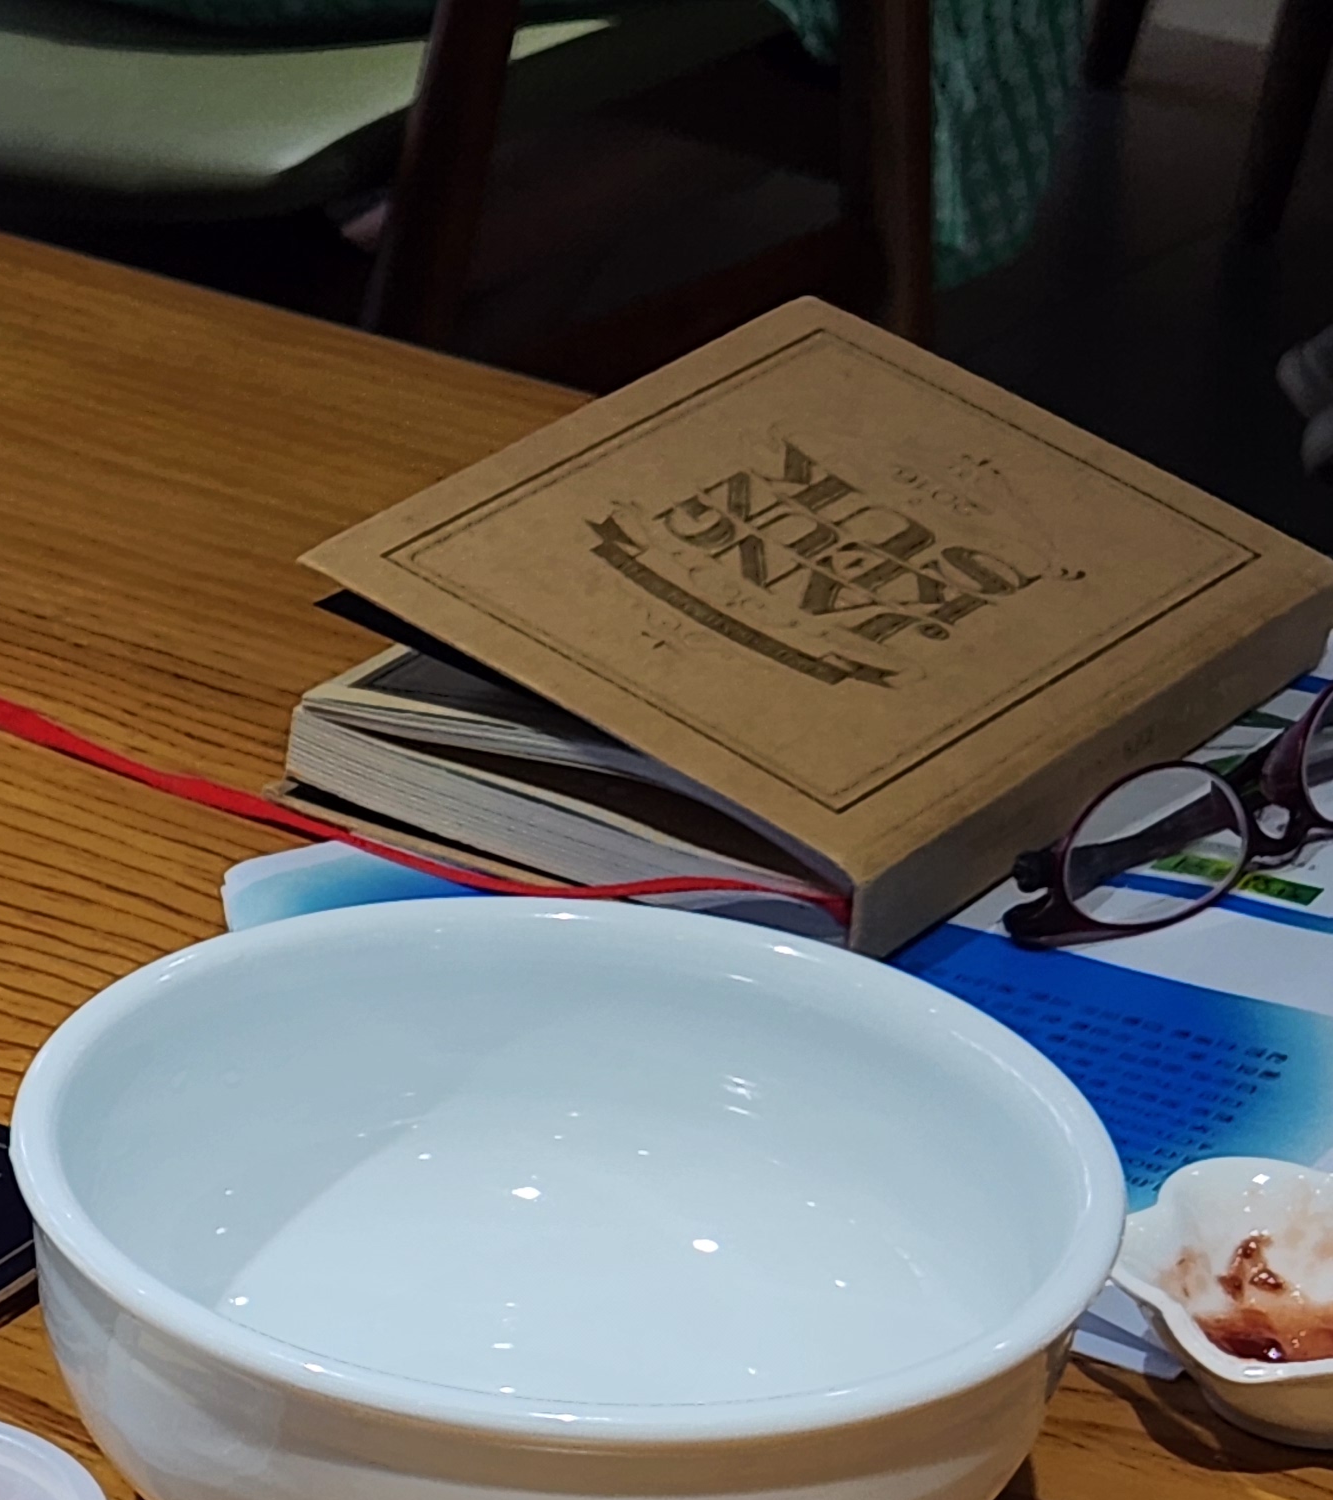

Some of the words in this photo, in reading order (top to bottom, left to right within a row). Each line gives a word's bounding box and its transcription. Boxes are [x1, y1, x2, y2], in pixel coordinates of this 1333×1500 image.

[651, 493, 951, 645] JANG
[699, 471, 997, 625] KEUN
[750, 439, 1041, 596] SUK
